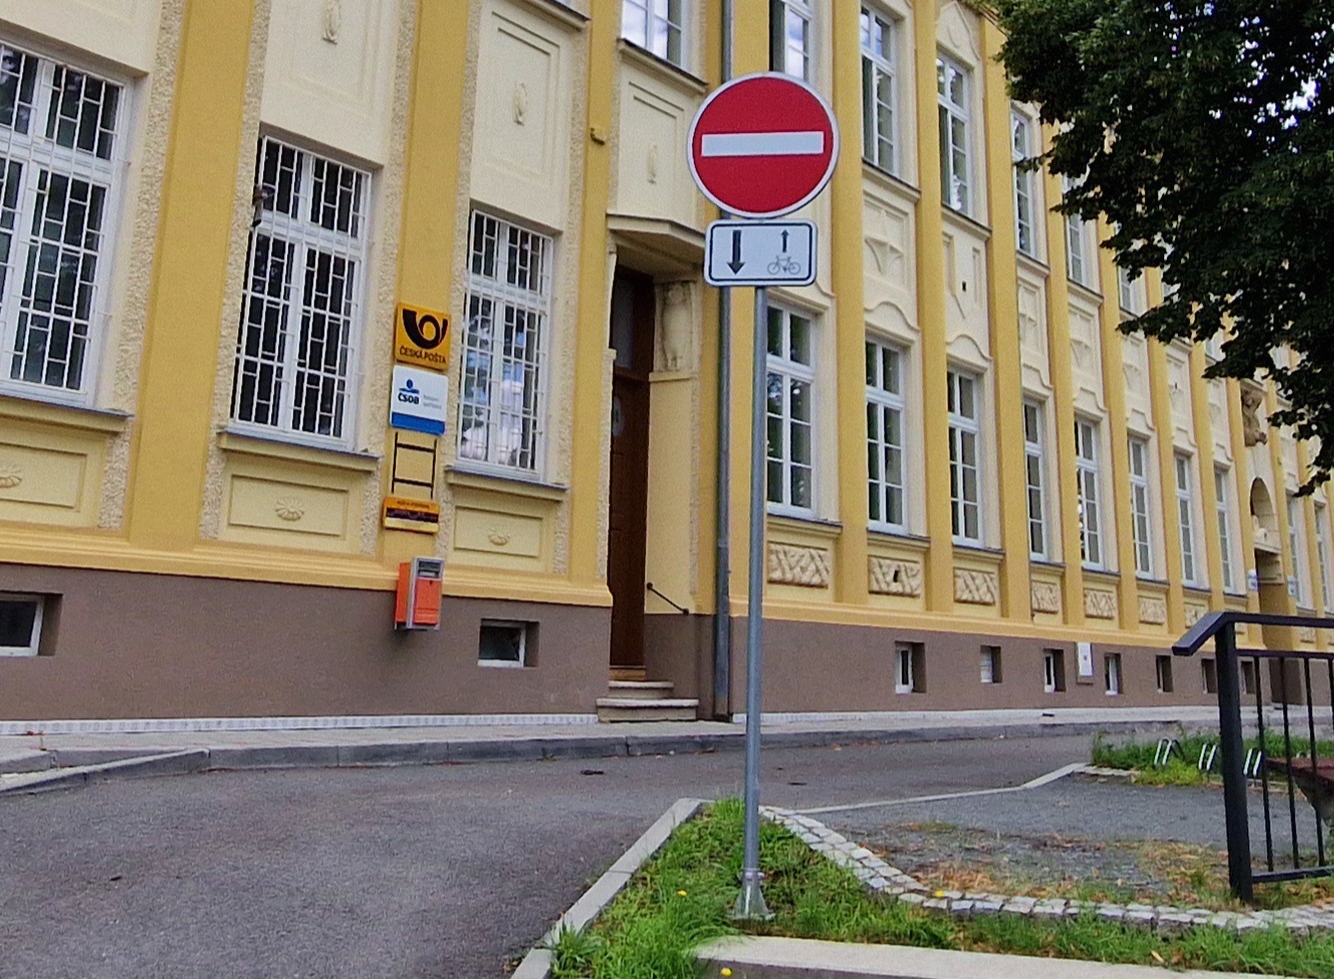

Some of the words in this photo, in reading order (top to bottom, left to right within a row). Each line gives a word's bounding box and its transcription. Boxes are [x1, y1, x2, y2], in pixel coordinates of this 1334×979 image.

[399, 344, 423, 359] ČESKÁ
[423, 350, 447, 364] POŠTA
[397, 392, 420, 405] ČSOB
